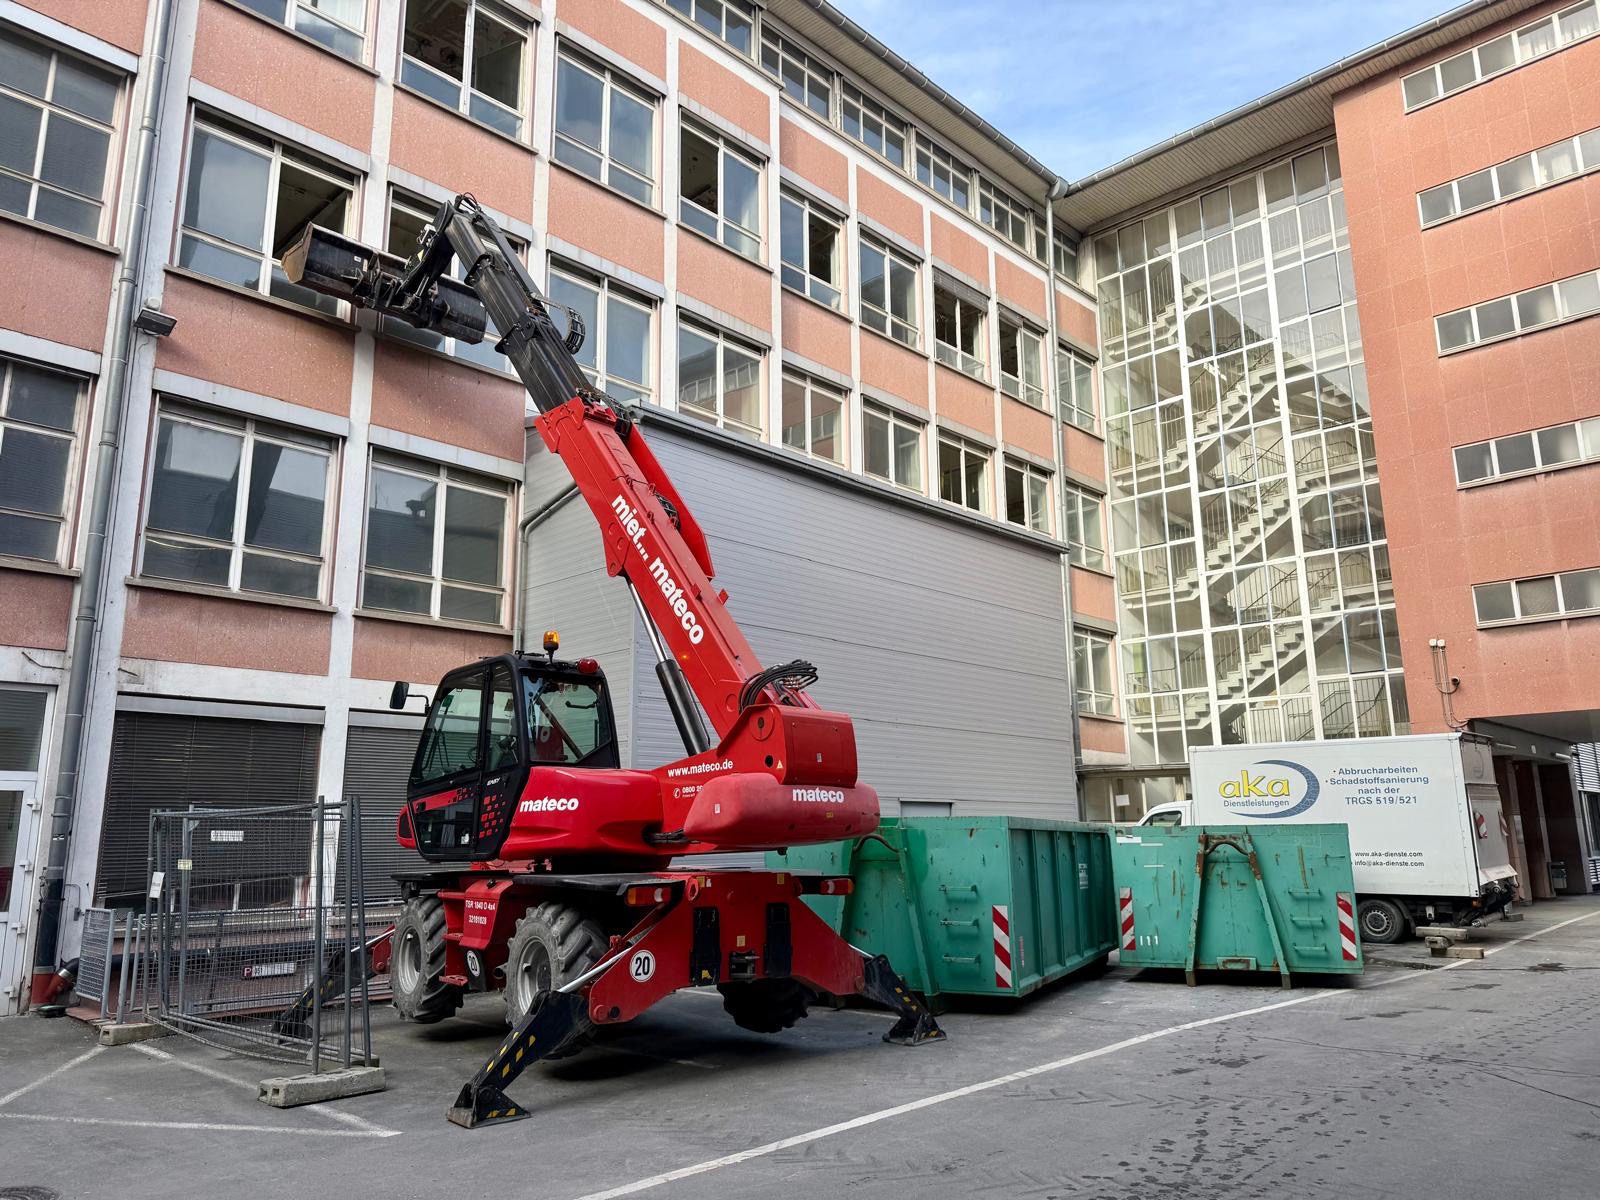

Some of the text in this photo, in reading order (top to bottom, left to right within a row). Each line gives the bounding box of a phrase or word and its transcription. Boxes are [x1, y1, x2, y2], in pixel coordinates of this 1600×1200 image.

[649, 557, 704, 645] mateco
[668, 758, 733, 777] www.mateco.de
[1339, 766, 1418, 775] Abbrucharbeiten
[1219, 770, 1291, 798] aka
[1330, 776, 1429, 785] Schadstoffsanierung
[682, 786, 695, 794] 0800
[792, 787, 844, 803] mateco
[519, 796, 579, 812] mateco
[1223, 799, 1290, 808] Dienstleistungen
[1345, 796, 1417, 805] TRGS 519/521
[635, 956, 650, 977] 20
